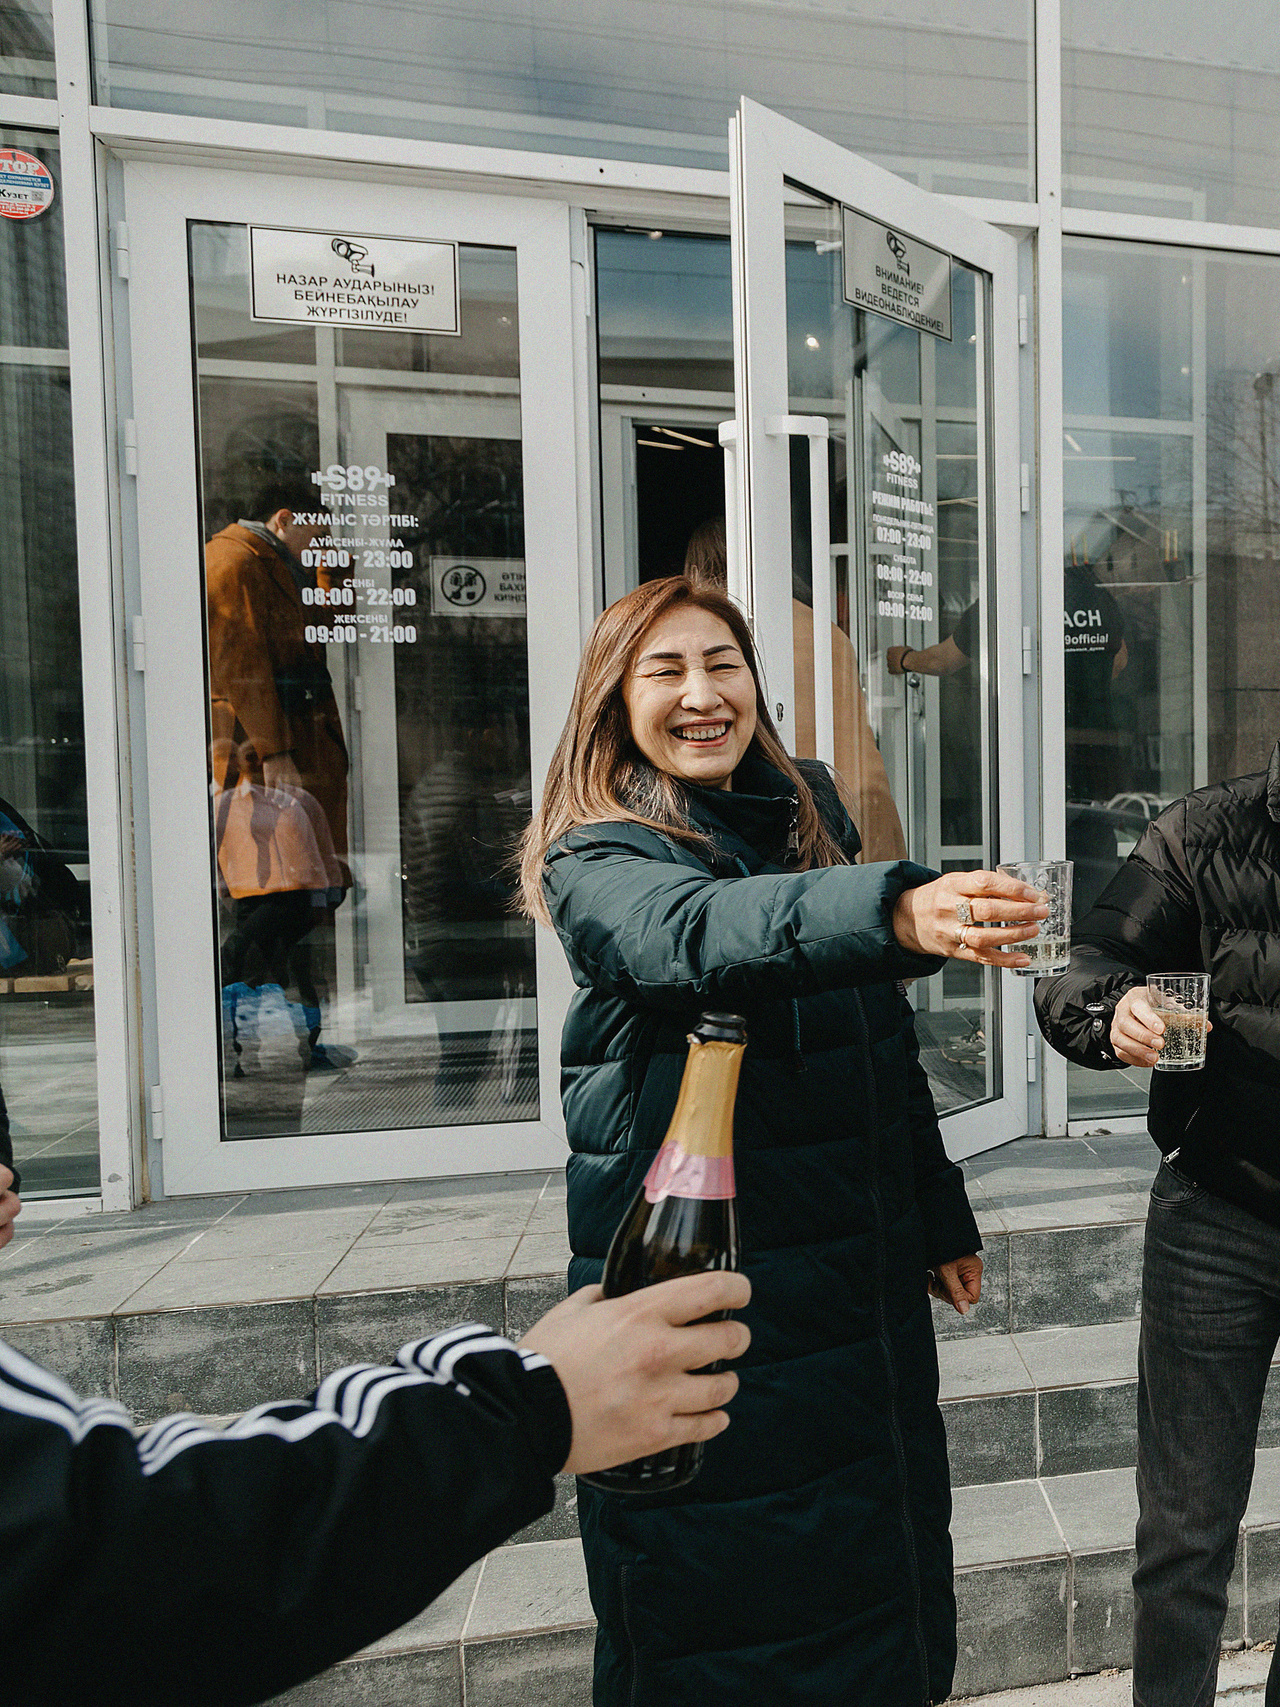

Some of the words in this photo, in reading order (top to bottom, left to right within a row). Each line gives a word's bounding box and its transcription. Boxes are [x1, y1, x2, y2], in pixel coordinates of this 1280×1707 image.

[276, 273, 328, 287] НАЗАР
[875, 265, 924, 295] ВНИМАНИЕ!
[294, 289, 420, 309] БЕЙНЕБАҚЫЛАУ
[881, 283, 920, 308] ВЕДЕТСЯ
[855, 287, 944, 333] ВИДЕОНАБЛЮДЕНИЕ!
[890, 450, 915, 476] S89
[324, 464, 384, 492] S89
[886, 472, 919, 489] FITNESS
[320, 493, 389, 507] FITNESS
[872, 490, 901, 510] РЕЖИМ
[876, 526, 902, 545] 07:00
[906, 532, 932, 551] 23:00
[301, 549, 350, 568] 07:00
[363, 550, 414, 569] 23:00
[343, 578, 375, 588] СЕНБІ
[876, 563, 904, 583] 08:00
[908, 568, 933, 587] 22:00
[301, 587, 354, 606] 08:00
[366, 588, 417, 606] 22:00
[878, 601, 905, 619] 09:00
[910, 604, 933, 622] 21:00
[304, 625, 357, 644] 09:00
[369, 625, 417, 644] 21:00
